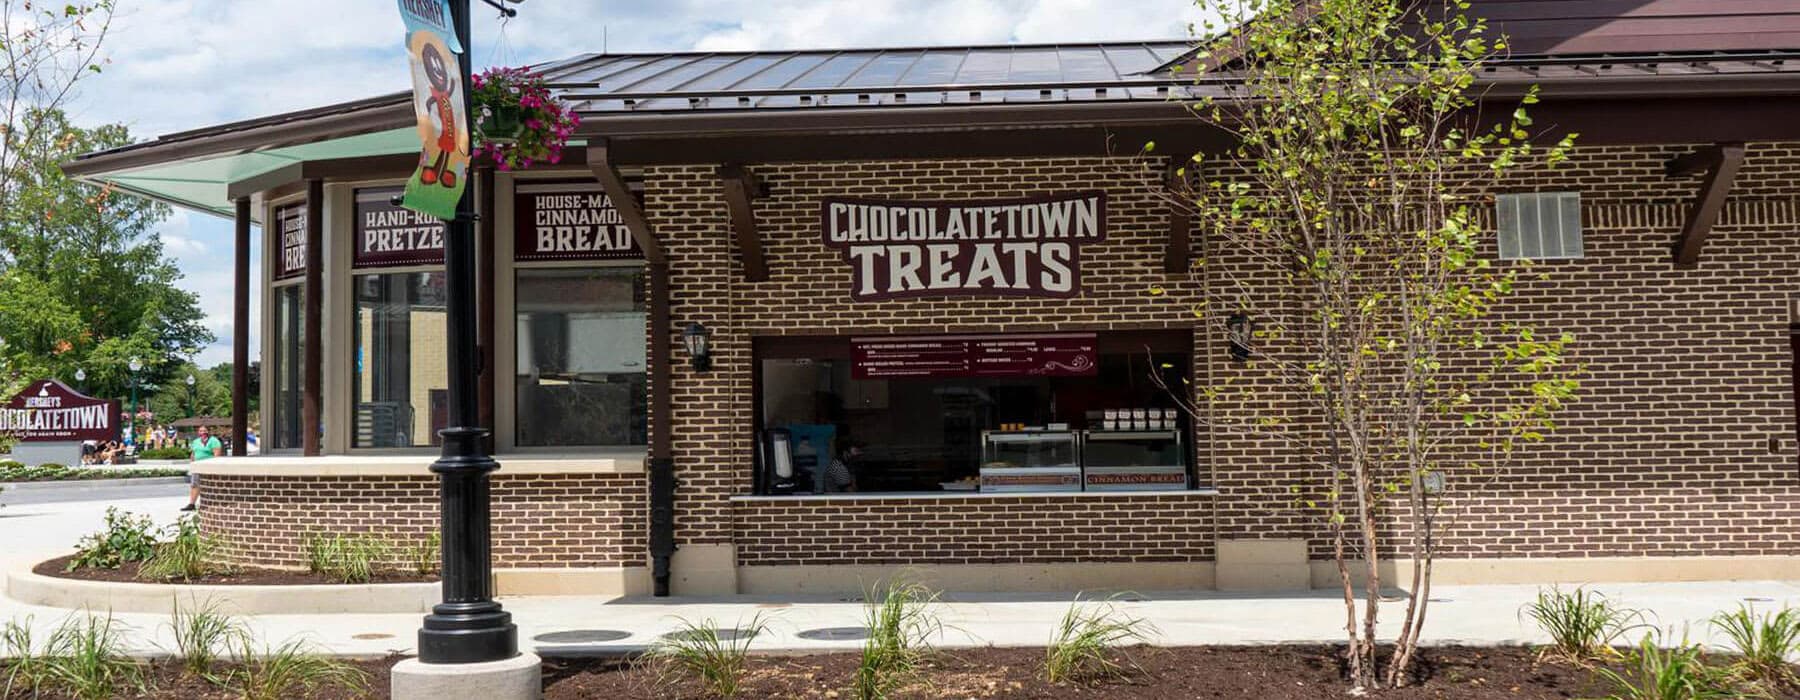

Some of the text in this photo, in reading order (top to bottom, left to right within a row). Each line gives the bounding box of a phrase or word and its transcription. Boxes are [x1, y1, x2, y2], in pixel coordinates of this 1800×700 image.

[536, 194, 614, 209] HOUSE-MA
[829, 197, 1098, 243] CHOCOLATETOWN
[364, 226, 444, 252] PRETZE
[536, 225, 632, 252] BREAD
[286, 245, 305, 270] BRE
[850, 242, 1073, 296] TREATS
[0, 403, 109, 430] OCOLATETOWN
